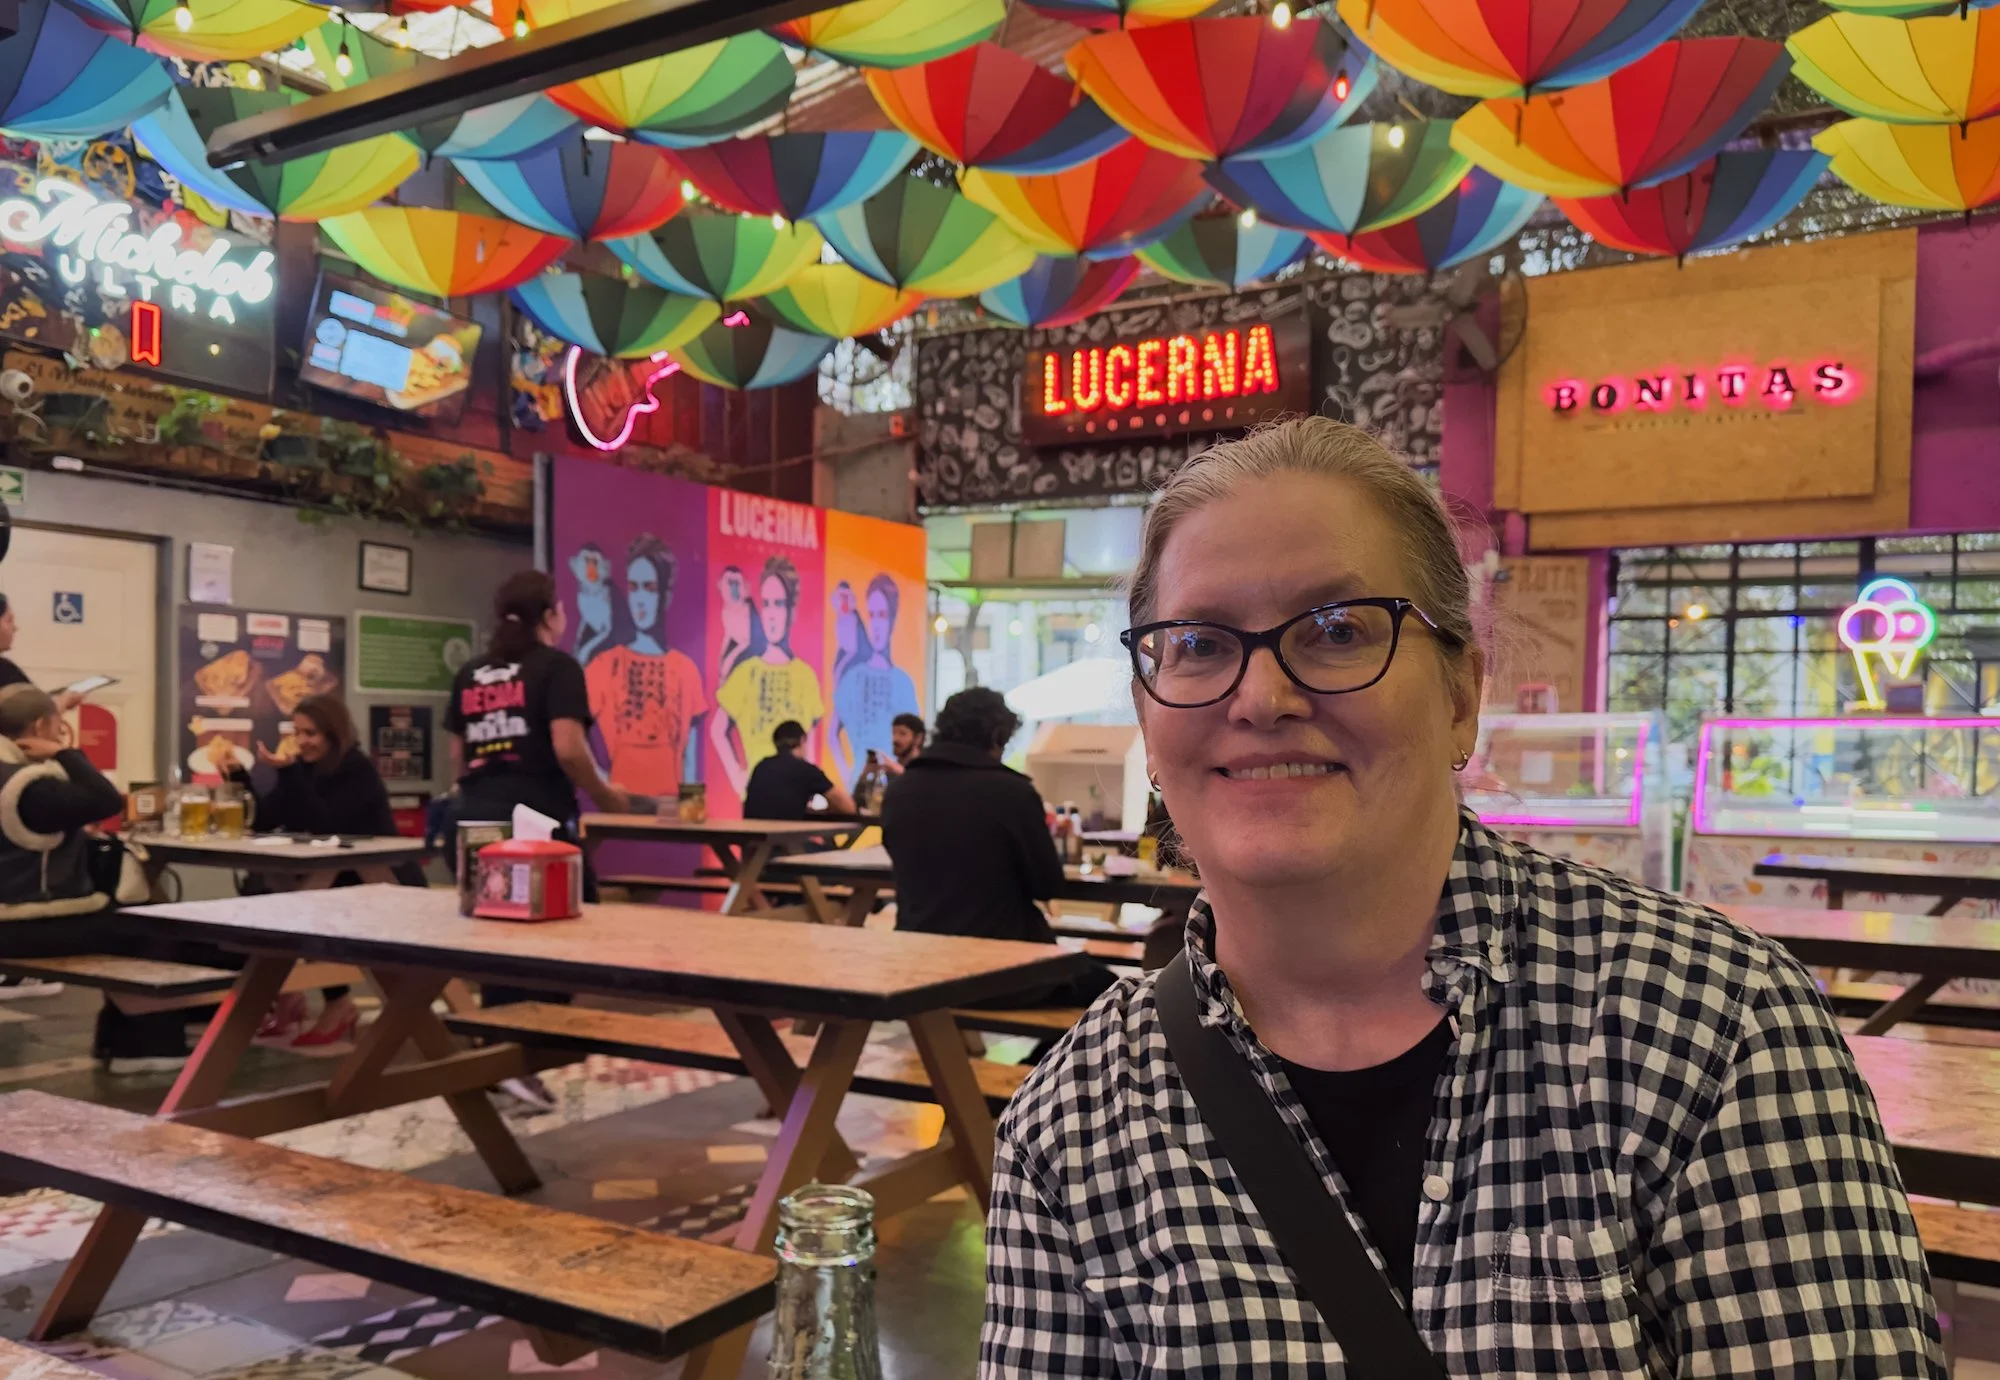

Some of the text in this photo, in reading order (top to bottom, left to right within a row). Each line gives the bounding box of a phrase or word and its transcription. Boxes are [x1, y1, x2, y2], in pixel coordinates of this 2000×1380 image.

[60, 253, 236, 324] ULTRA
[1043, 323, 1279, 417] LUCERNA
[1553, 362, 1844, 412] BONITAS
[720, 489, 819, 551] LUCERNA
